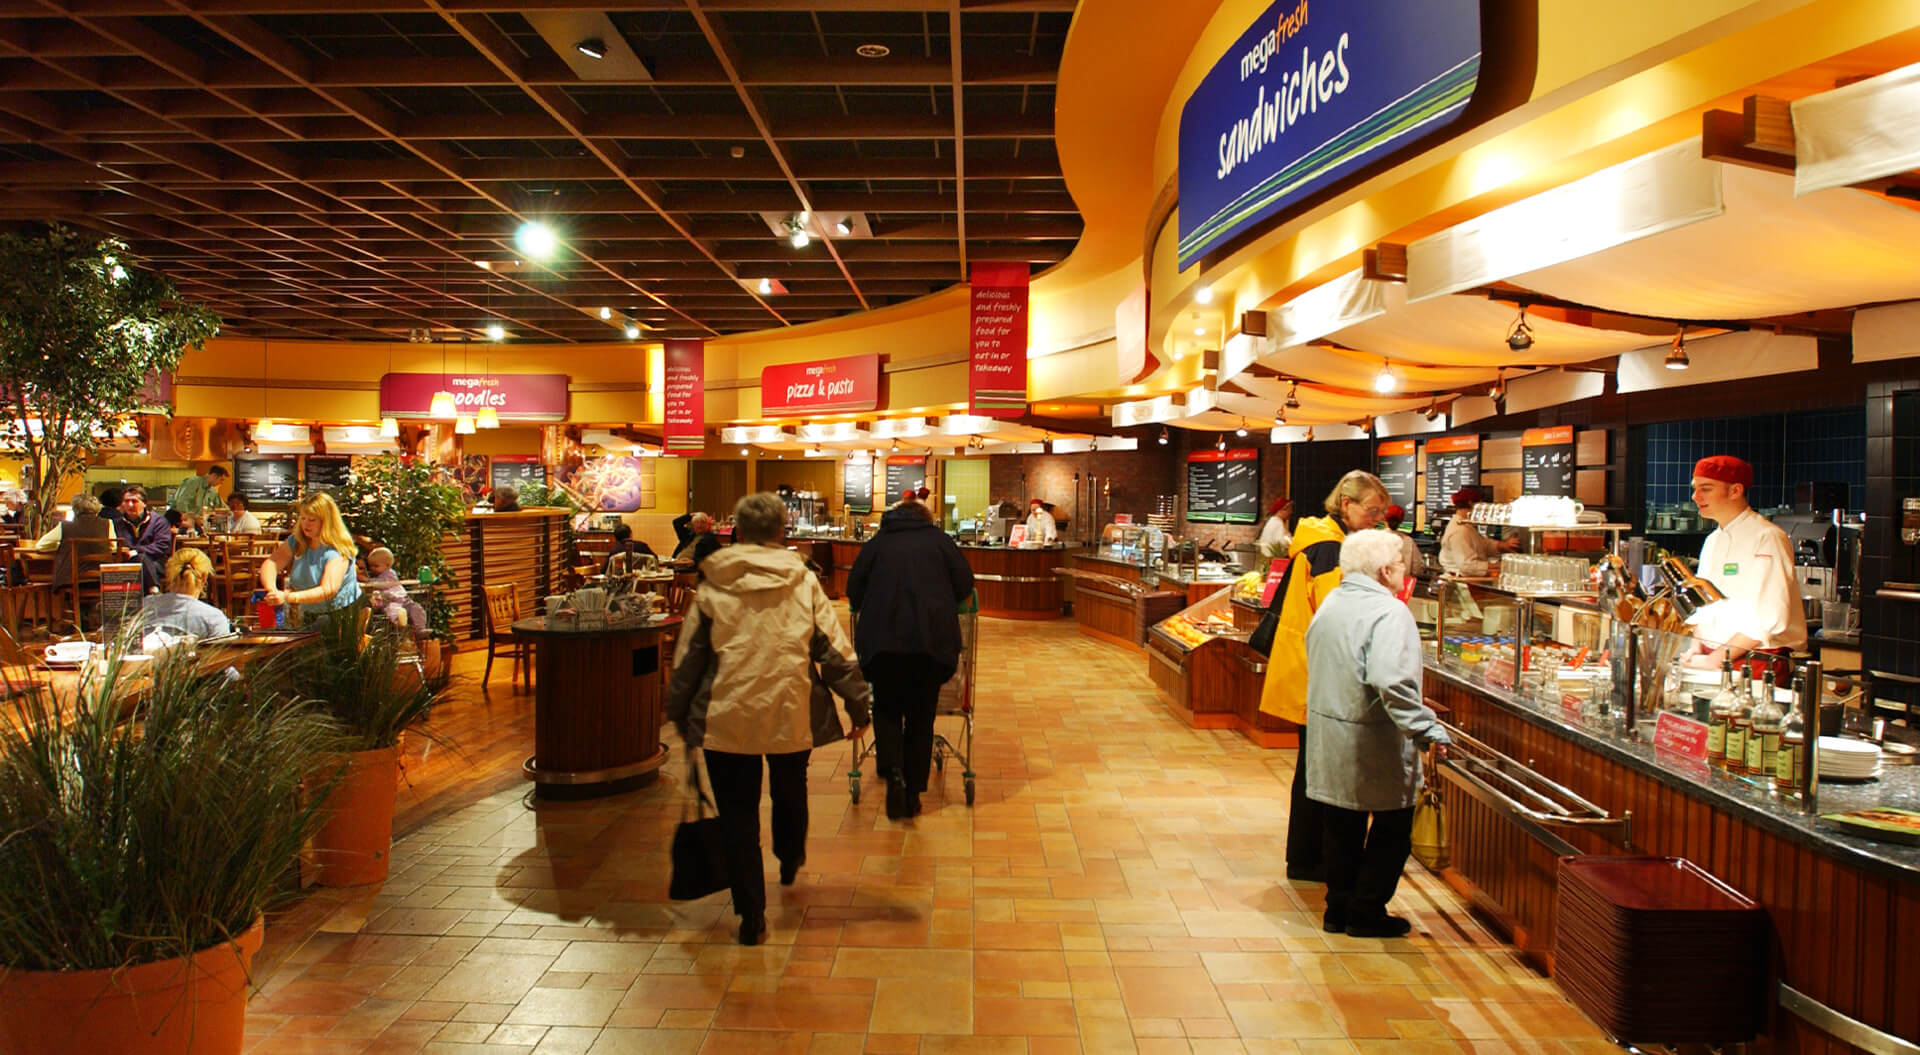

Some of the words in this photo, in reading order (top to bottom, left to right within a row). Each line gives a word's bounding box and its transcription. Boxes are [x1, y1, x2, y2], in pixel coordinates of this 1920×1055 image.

[1217, 32, 1350, 180] sandwiches
[976, 290, 1011, 299] delicious
[976, 303, 991, 311] and
[993, 302, 1022, 312] freshly
[975, 315, 1012, 324] prepared
[975, 327, 995, 336] food
[997, 327, 1011, 336] for
[975, 340, 989, 349] you
[991, 340, 1001, 348] to
[974, 352, 989, 360] eat
[990, 352, 999, 360] in
[974, 364, 1013, 374] takeaway
[452, 377, 499, 387] megafresh
[679, 374, 699, 383] freshly
[667, 383, 693, 391] prepared
[786, 382, 815, 403] pizza
[817, 380, 826, 396] &
[827, 377, 855, 400] pasta
